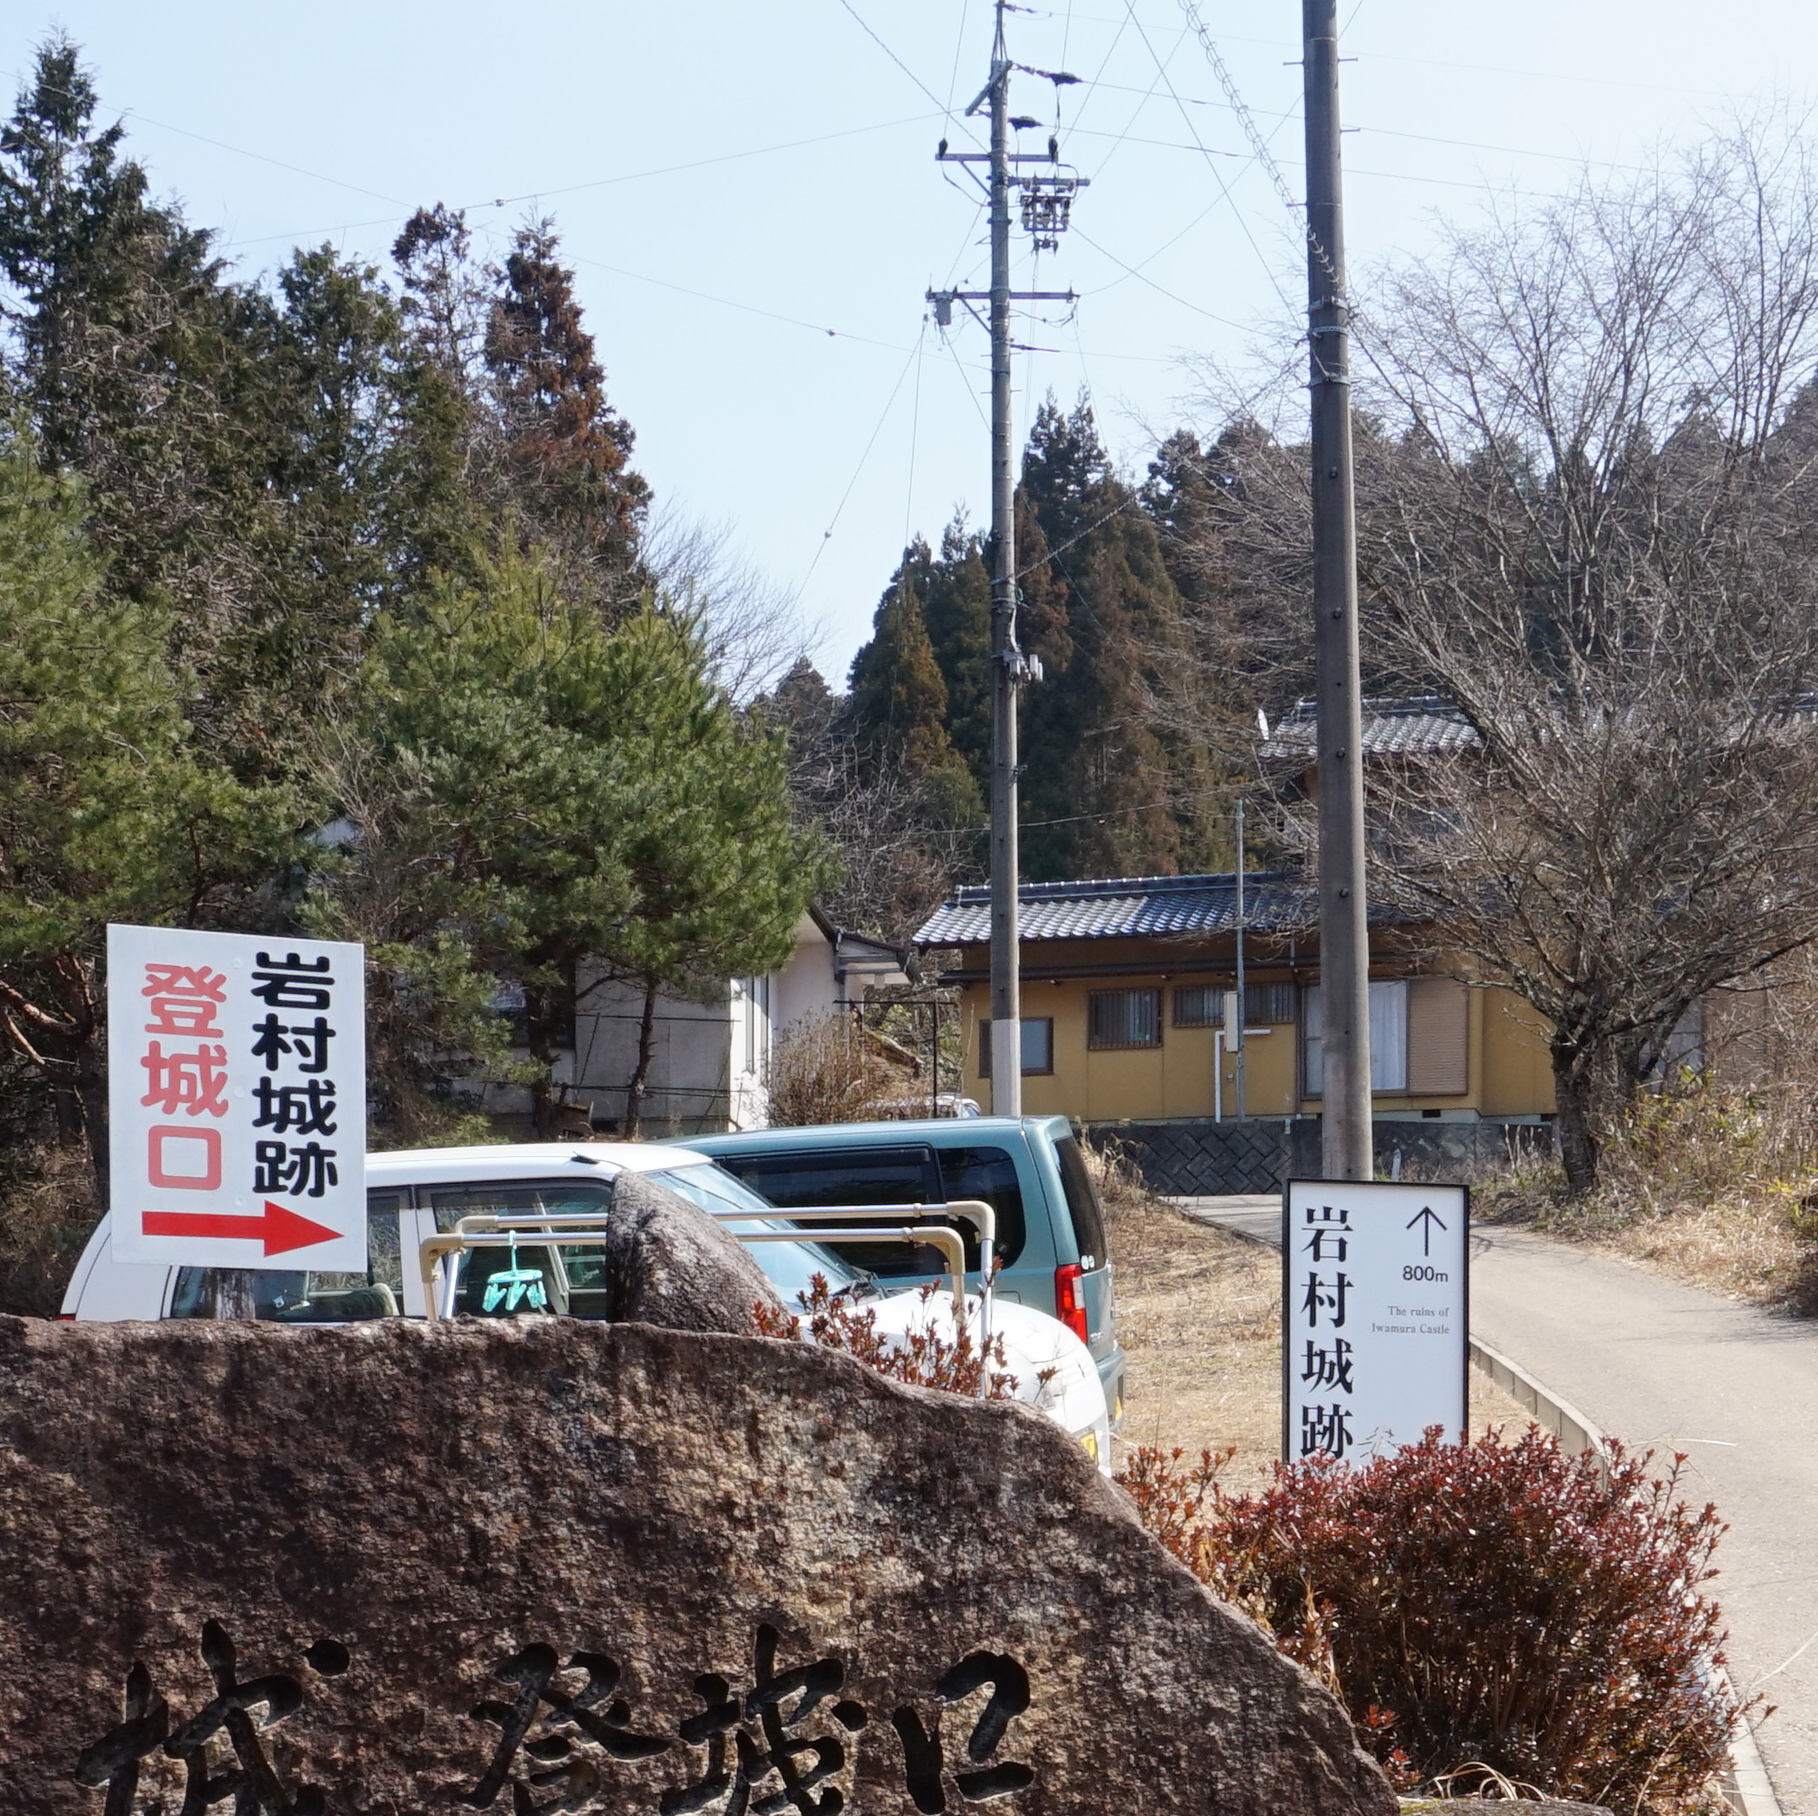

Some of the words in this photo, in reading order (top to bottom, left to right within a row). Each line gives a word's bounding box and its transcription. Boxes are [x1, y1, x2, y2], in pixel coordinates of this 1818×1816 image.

[140, 962, 229, 1191] 登城口
[251, 951, 338, 1198] 岩村城跡
[1300, 1205, 1355, 1460] 岩村城跡
[1371, 1322, 1416, 1334] Iwamura
[1419, 1323, 1451, 1335] Castle
[1387, 1305, 1407, 1317] The
[1410, 1306, 1435, 1317] ruins
[1438, 1306, 1450, 1318] of
[1402, 1265, 1449, 1283] 800m
